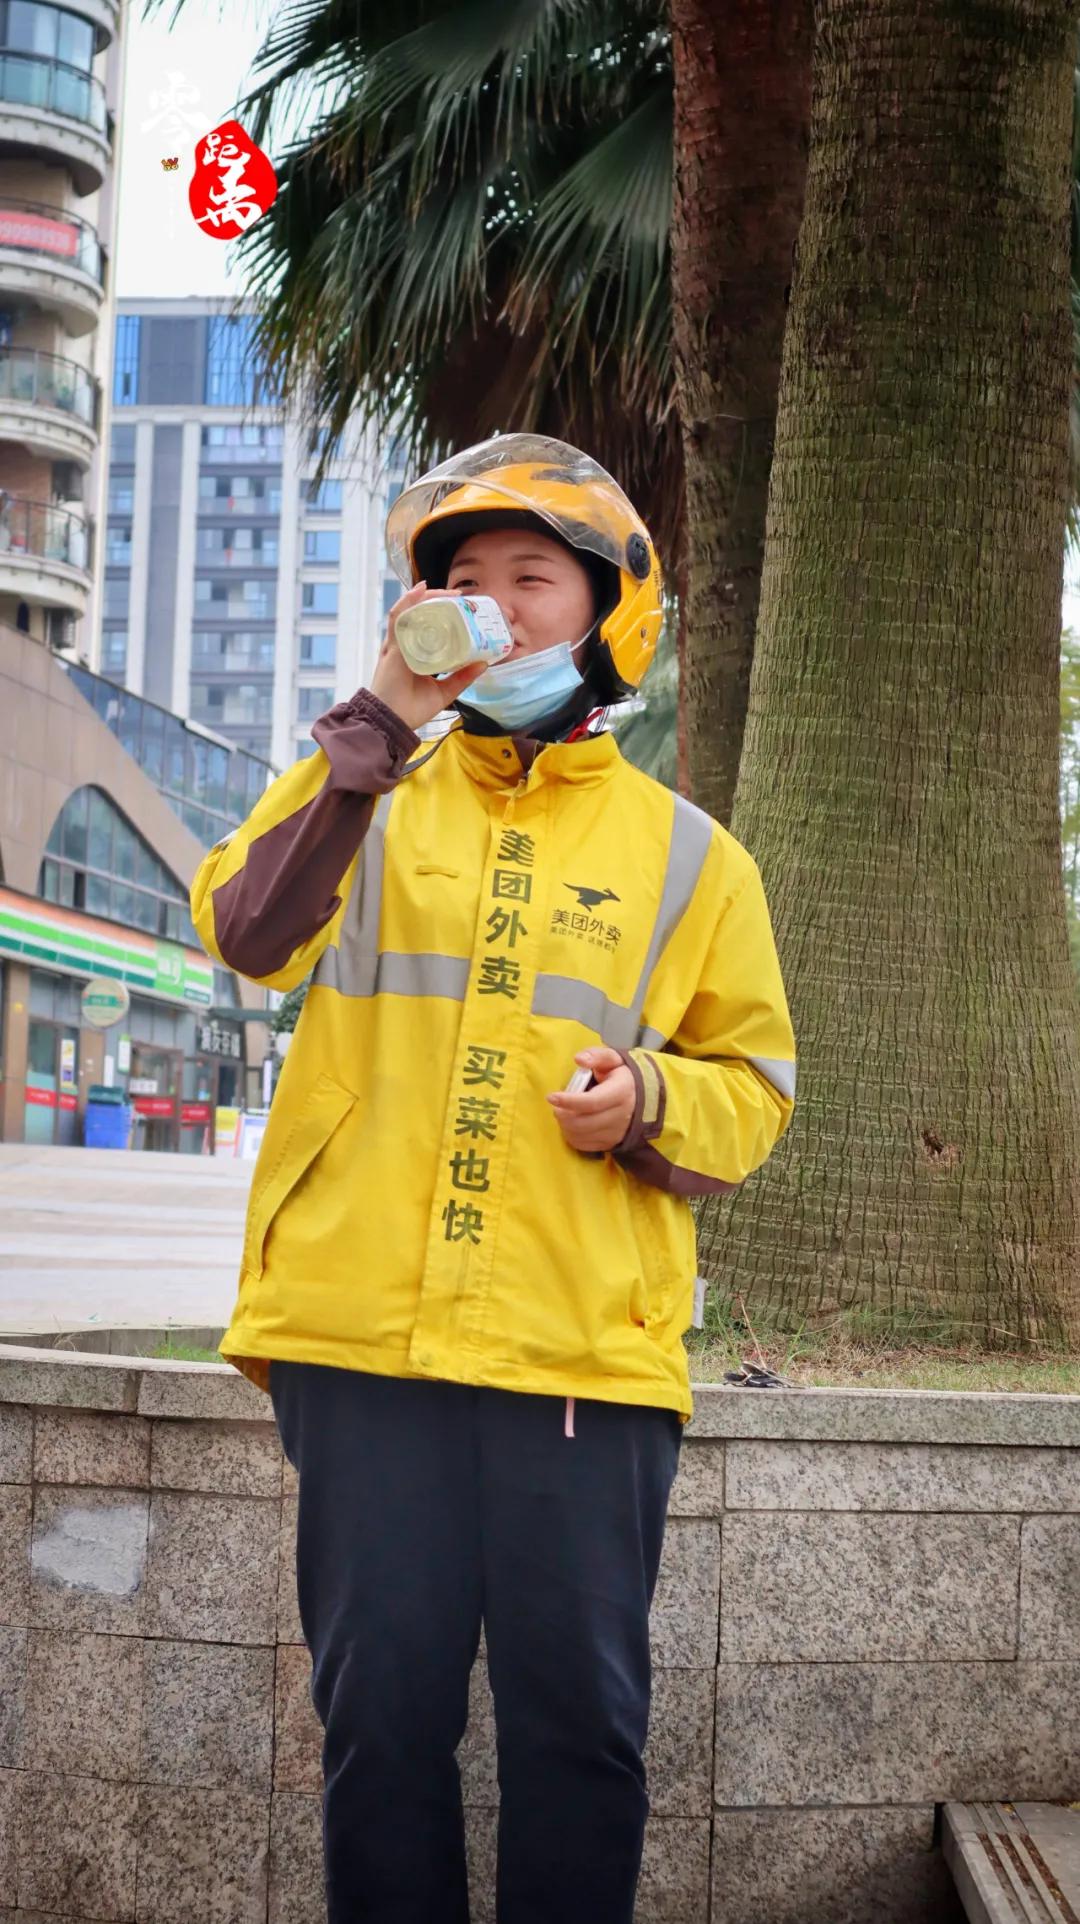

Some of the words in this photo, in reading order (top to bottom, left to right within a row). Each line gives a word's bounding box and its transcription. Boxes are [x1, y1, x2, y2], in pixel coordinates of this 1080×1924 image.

[477, 828, 535, 1000] 美团外卖
[551, 908, 622, 946] 美团外卖
[442, 1044, 508, 1245] 买菜也快
